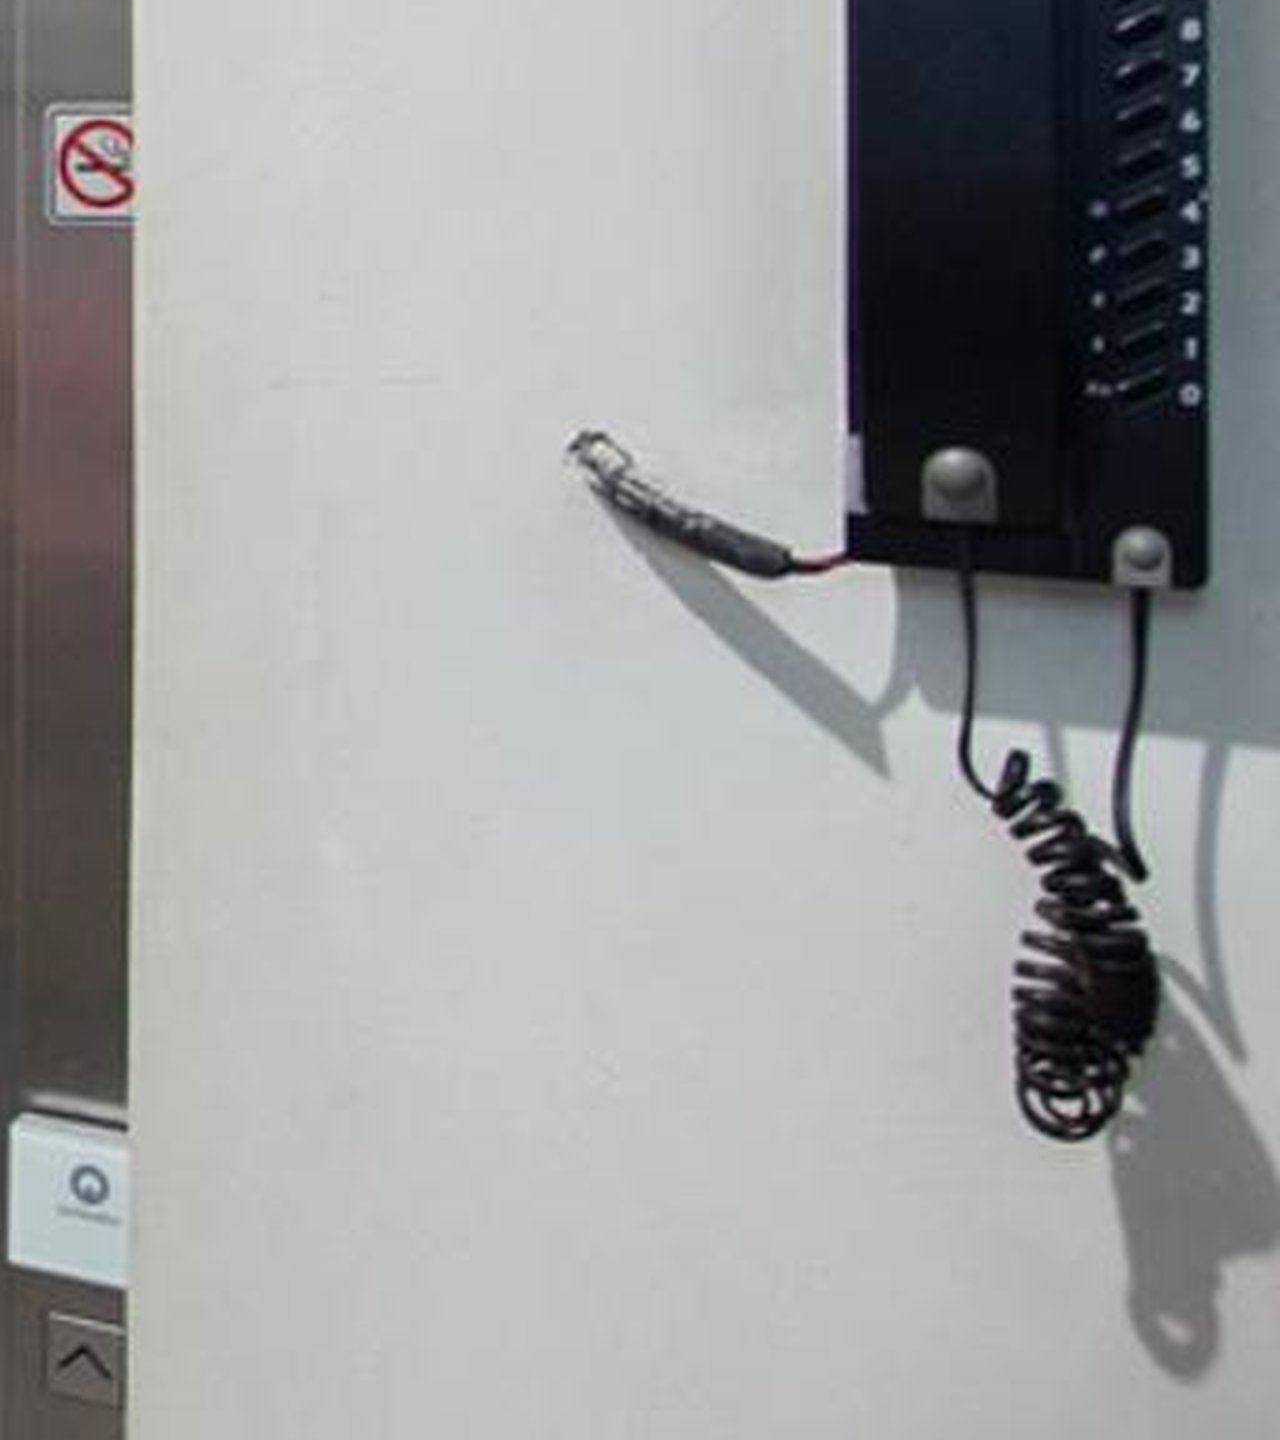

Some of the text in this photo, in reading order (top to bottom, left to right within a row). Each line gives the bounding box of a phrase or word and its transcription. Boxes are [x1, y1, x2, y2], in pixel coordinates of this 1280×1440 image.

[1178, 18, 1201, 42] 8
[1178, 62, 1201, 88] 7
[1178, 109, 1201, 132] 6
[1178, 153, 1201, 179] 5
[1178, 199, 1201, 222] 4
[1178, 245, 1201, 270] 3
[1178, 290, 1201, 315] 2
[1183, 336, 1199, 359] 1
[1178, 382, 1201, 407] 0
